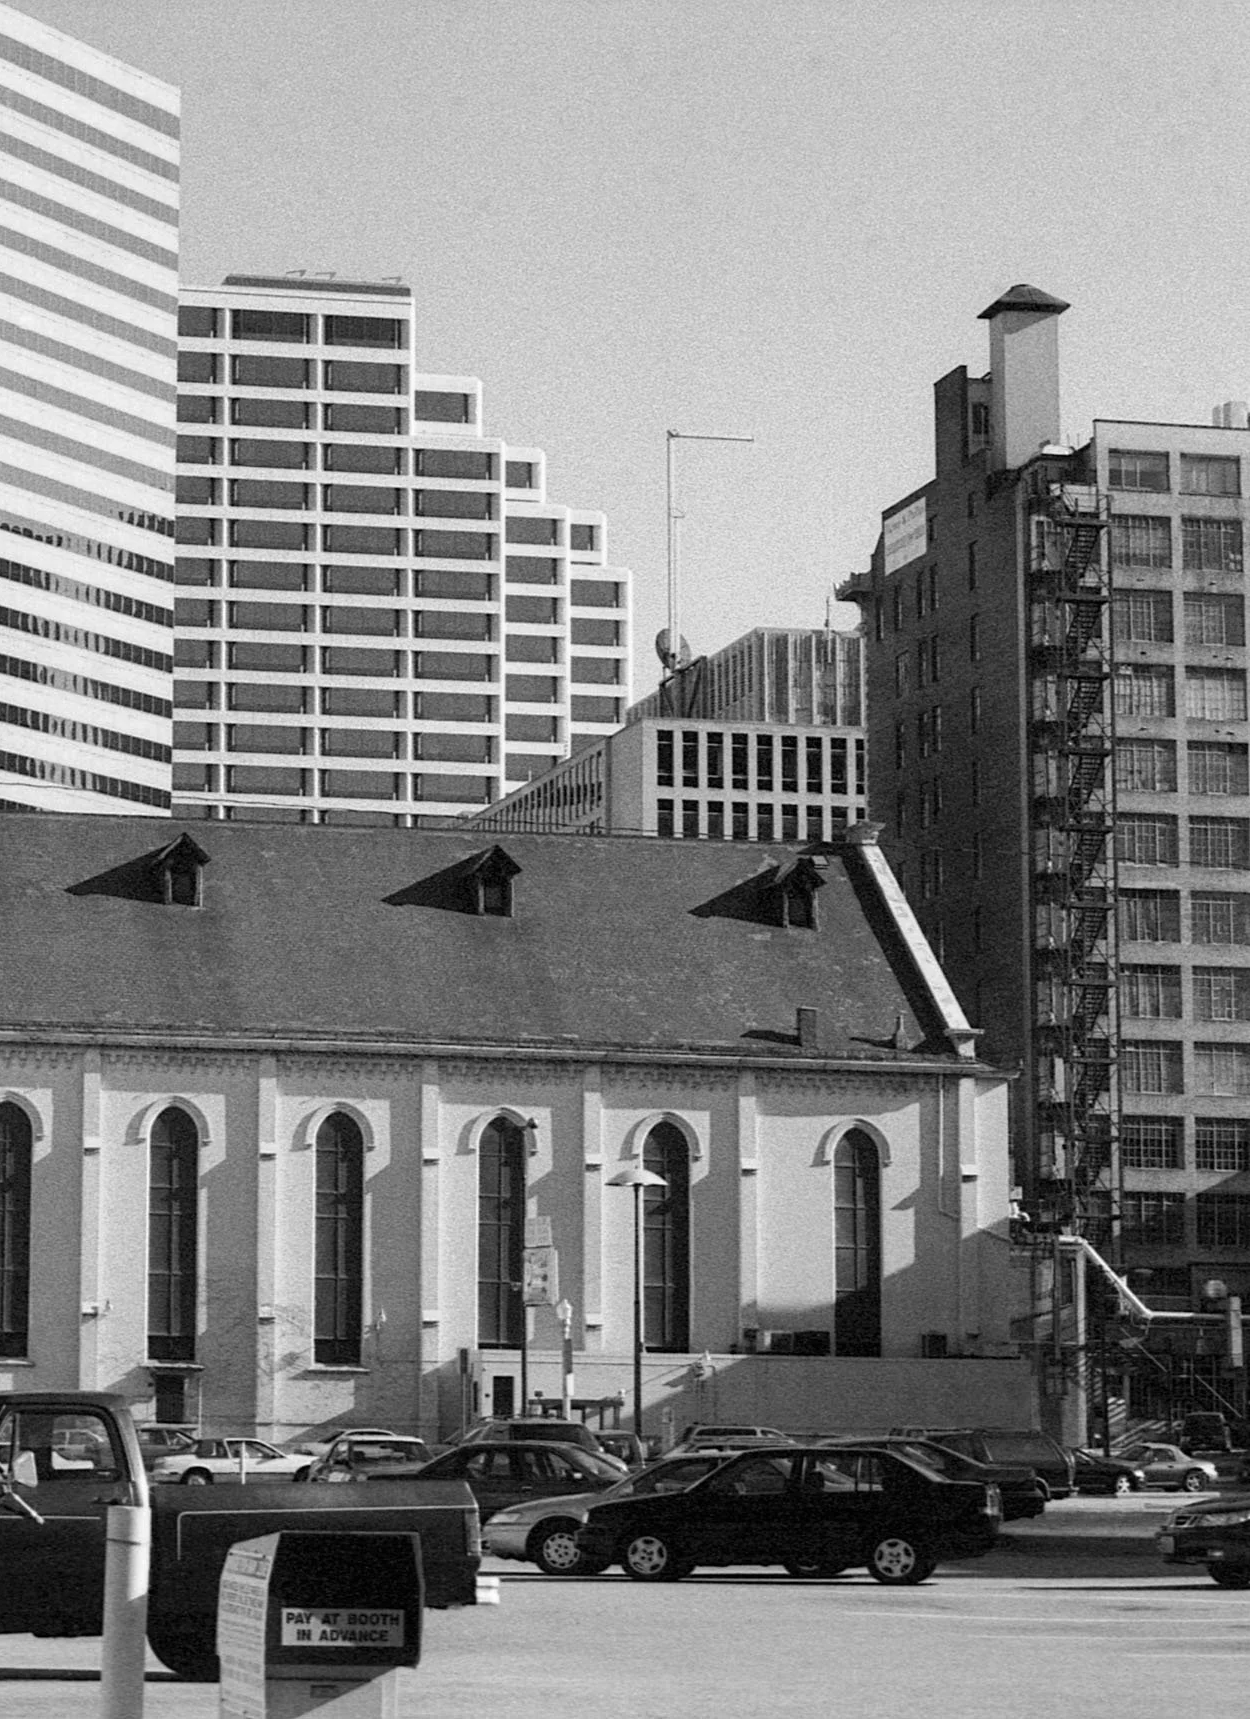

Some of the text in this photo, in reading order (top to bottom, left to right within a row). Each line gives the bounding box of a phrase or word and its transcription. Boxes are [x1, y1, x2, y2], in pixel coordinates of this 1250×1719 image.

[285, 1612, 400, 1626] PAY AT BOOTH
[296, 1629, 390, 1642] IN ADVANCE
